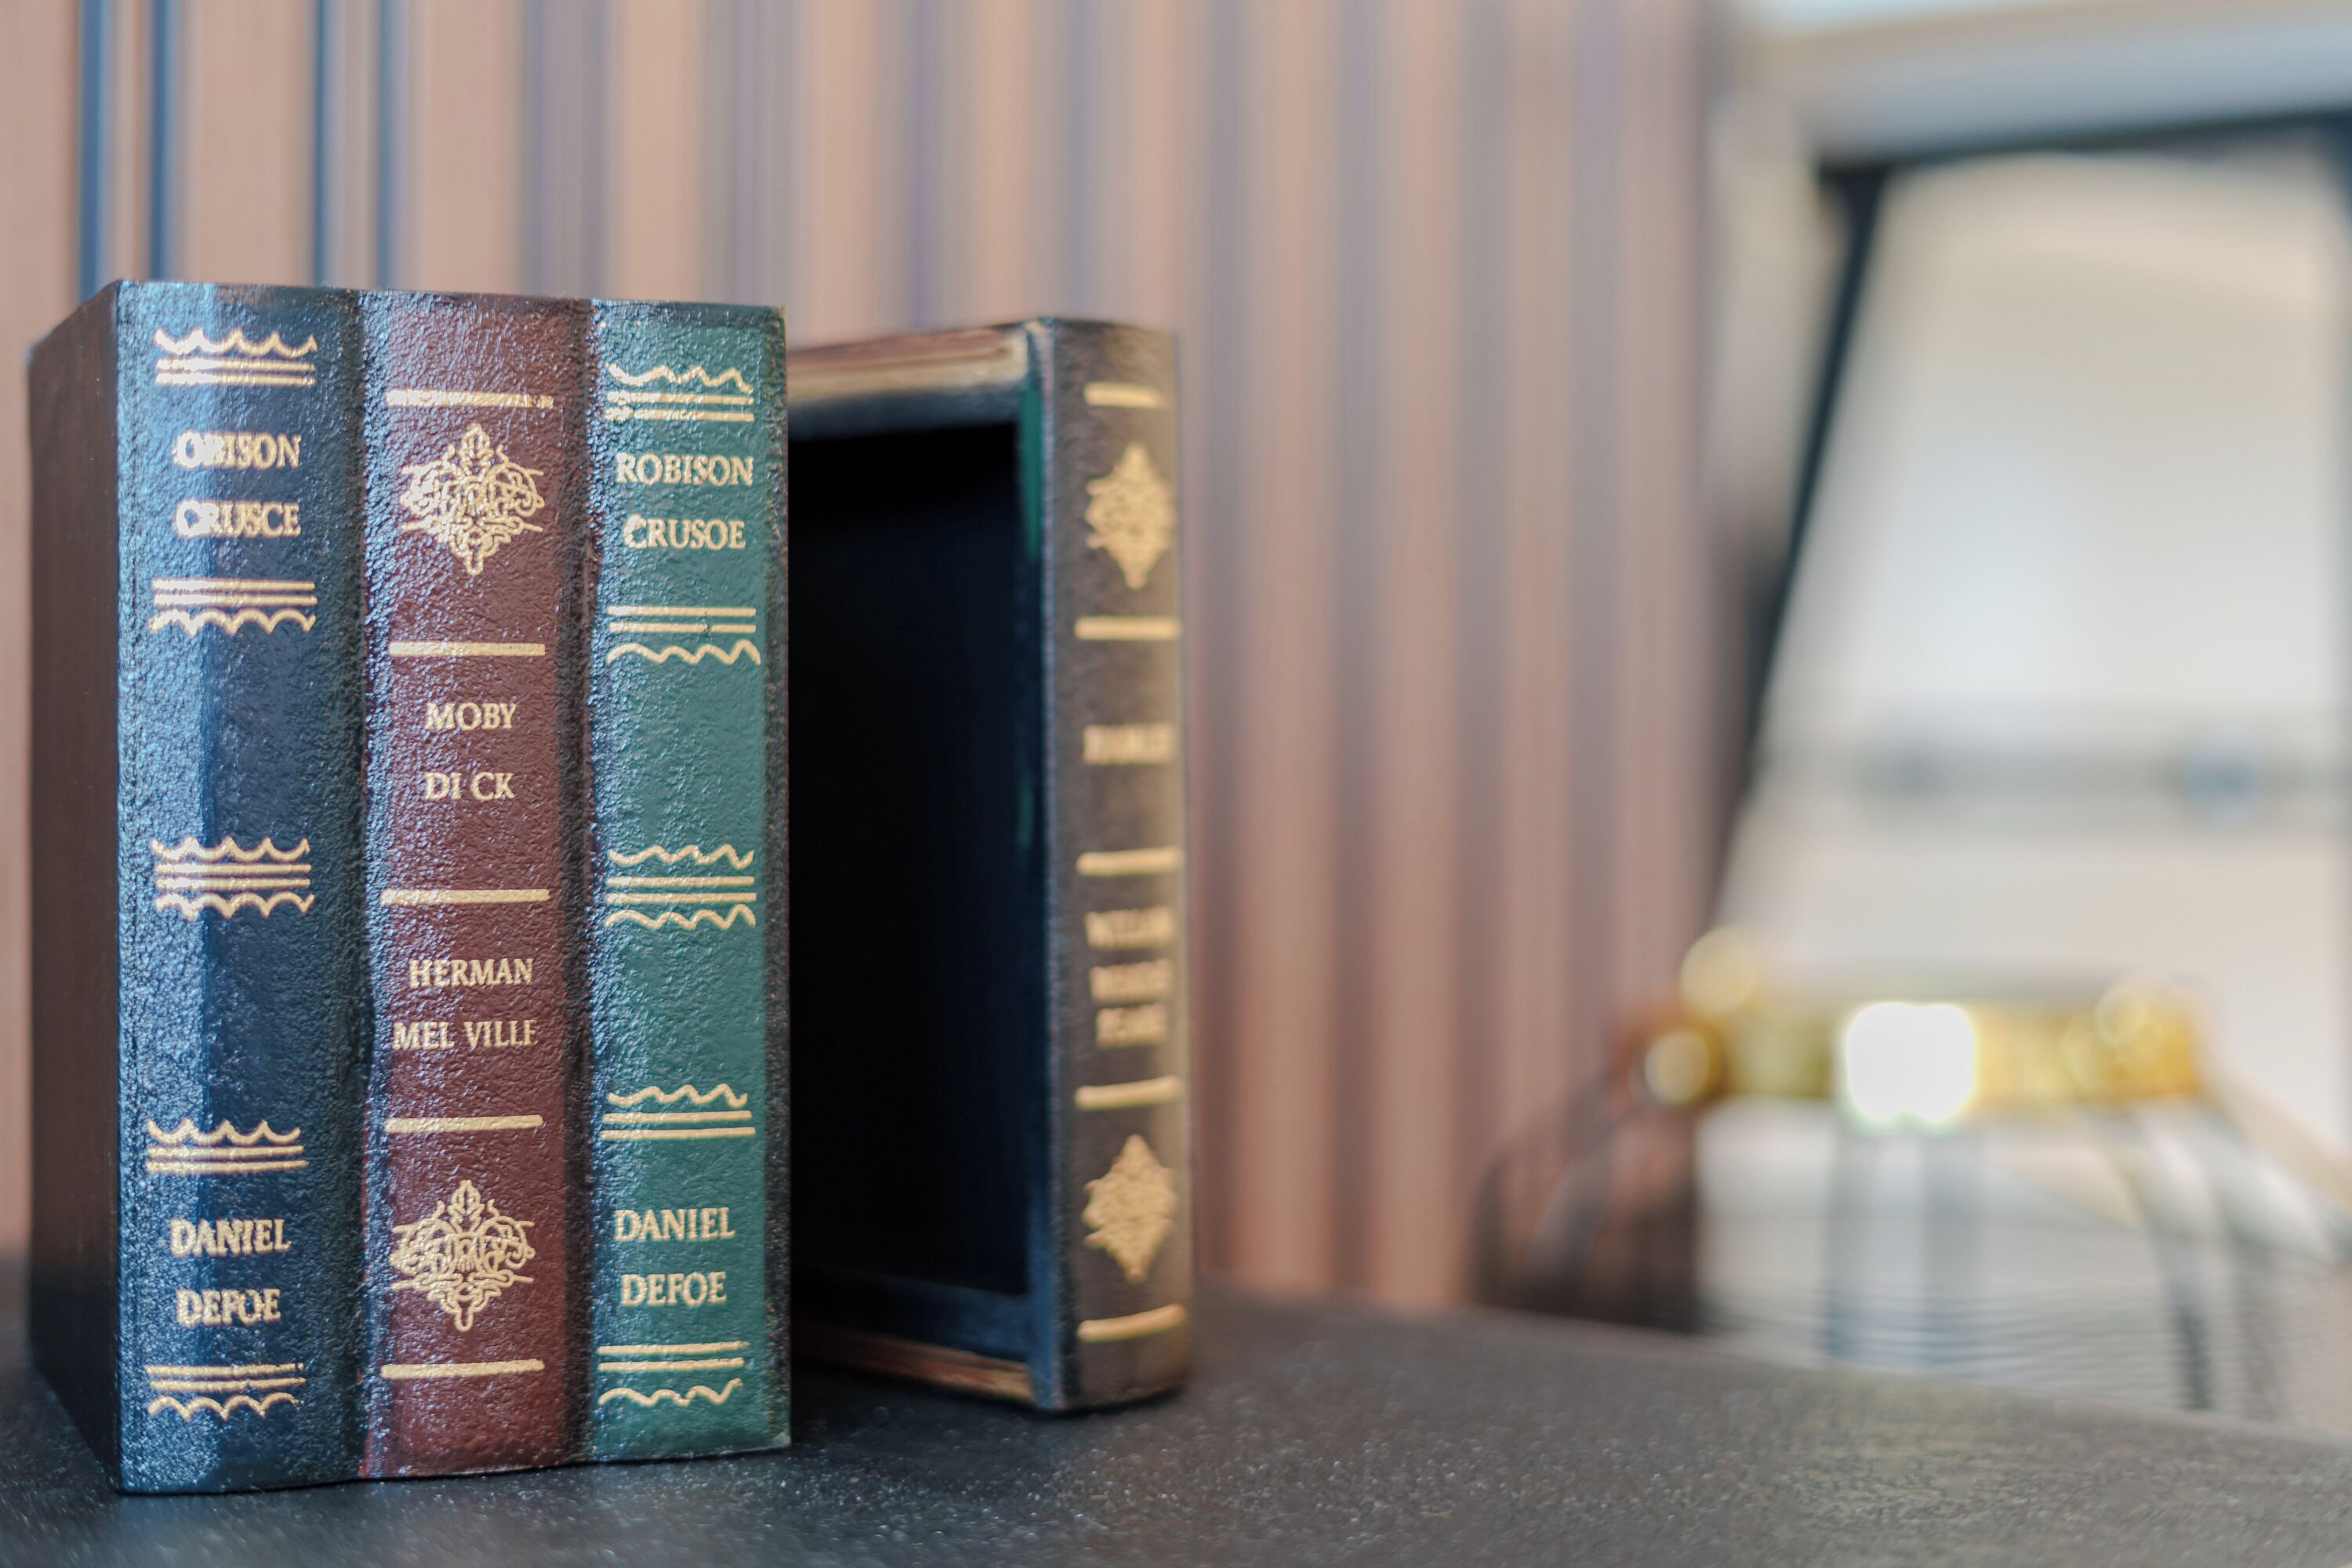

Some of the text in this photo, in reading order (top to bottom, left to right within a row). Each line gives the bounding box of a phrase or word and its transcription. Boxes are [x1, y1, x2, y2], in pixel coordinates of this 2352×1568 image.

[174, 430, 301, 469] OISON
[615, 452, 754, 486] ROBISON
[623, 514, 746, 550] CRUSOE
[424, 702, 517, 731] MOBY
[408, 958, 534, 989] HERMAN
[170, 1218, 292, 1256] DANIEL
[615, 1207, 736, 1242] DANIEL
[620, 1272, 728, 1308] DEFOE
